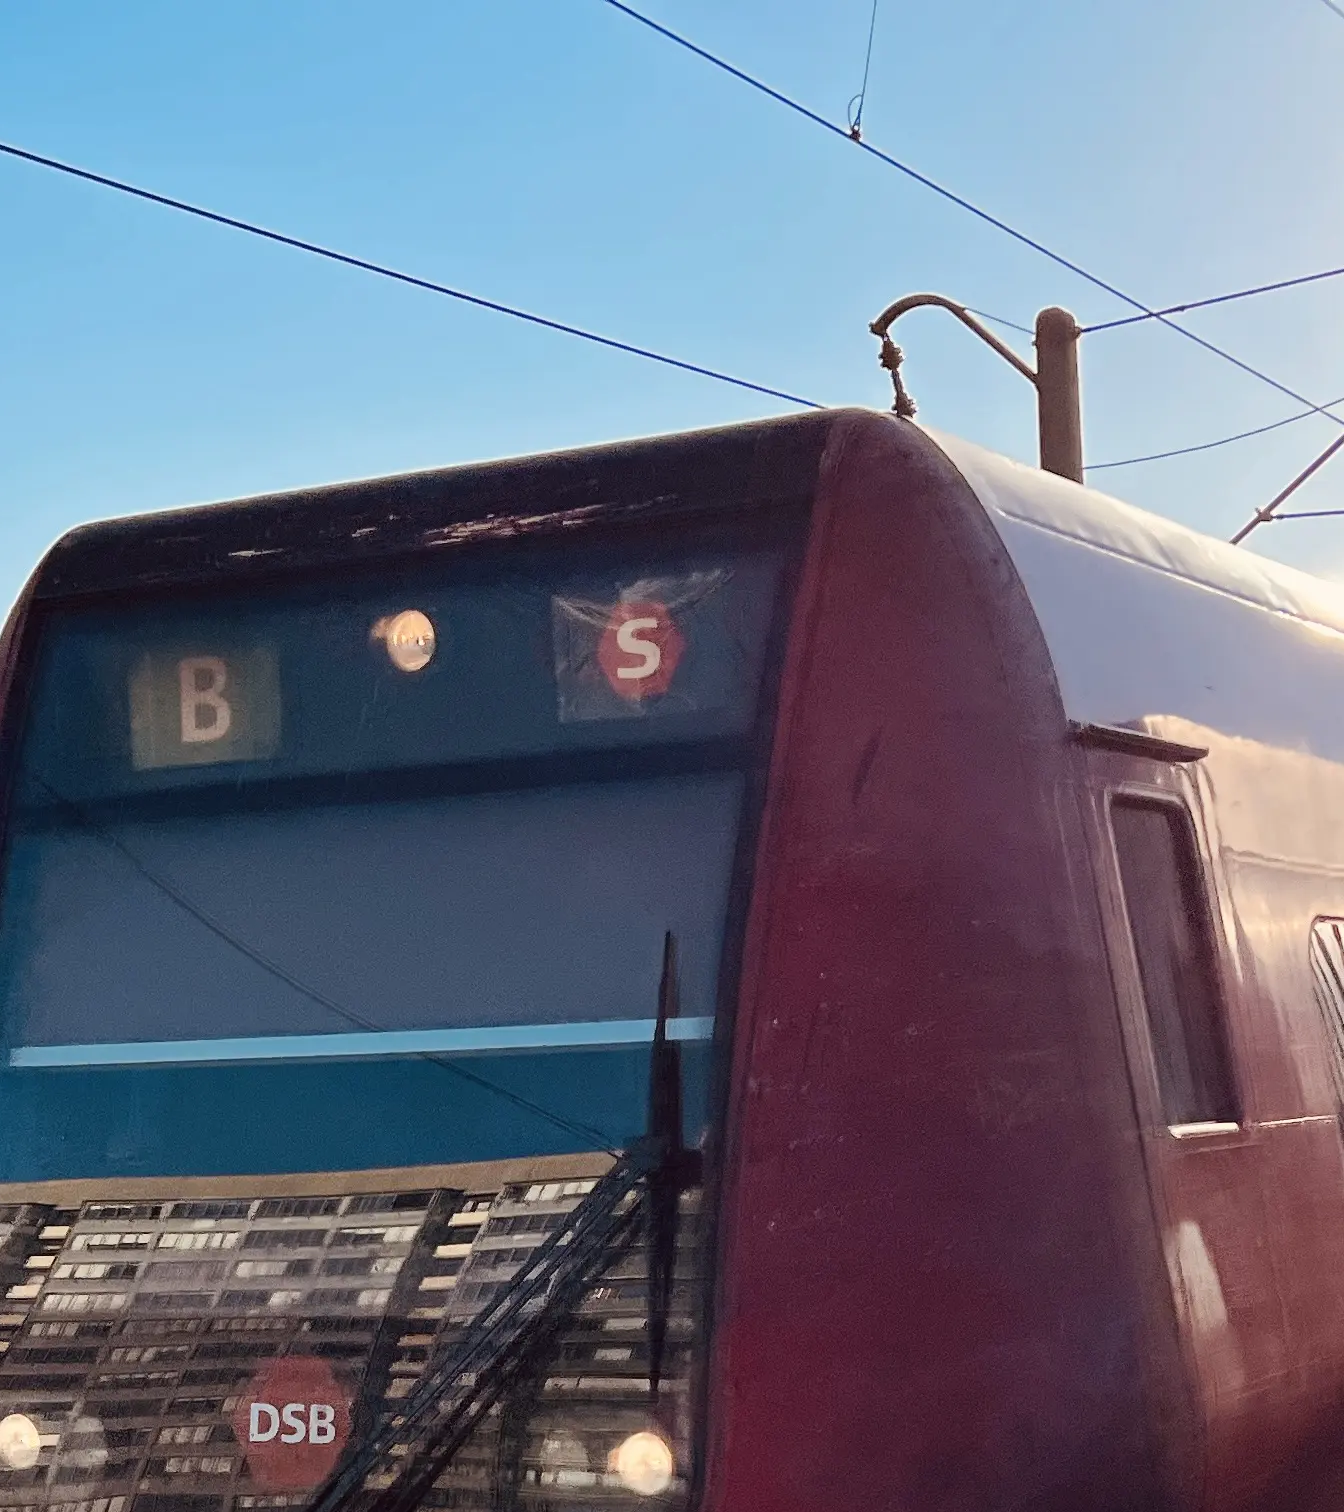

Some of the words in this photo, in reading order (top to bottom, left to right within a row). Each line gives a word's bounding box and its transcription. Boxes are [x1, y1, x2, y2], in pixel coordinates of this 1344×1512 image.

[617, 617, 660, 679] S
[180, 657, 230, 742] B
[249, 1403, 336, 1444] DSB
